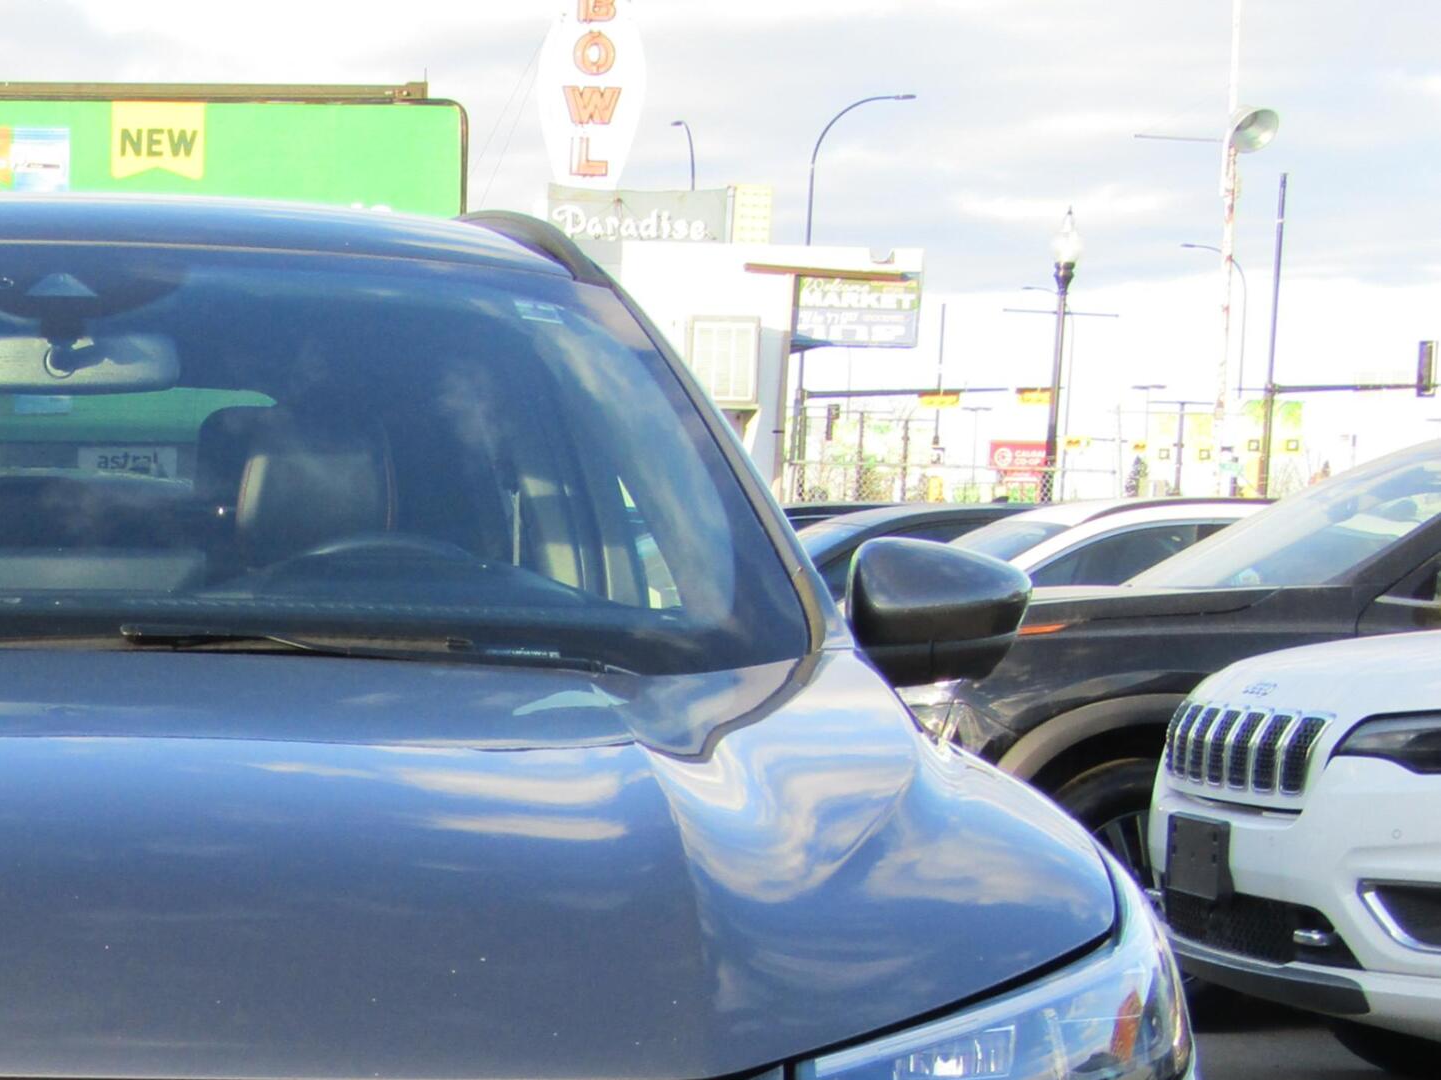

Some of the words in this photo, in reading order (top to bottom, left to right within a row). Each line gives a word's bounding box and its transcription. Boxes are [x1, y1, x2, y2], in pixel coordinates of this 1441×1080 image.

[562, 0, 622, 177] BOWL
[120, 128, 198, 157] NEW
[552, 204, 706, 241] Paradise
